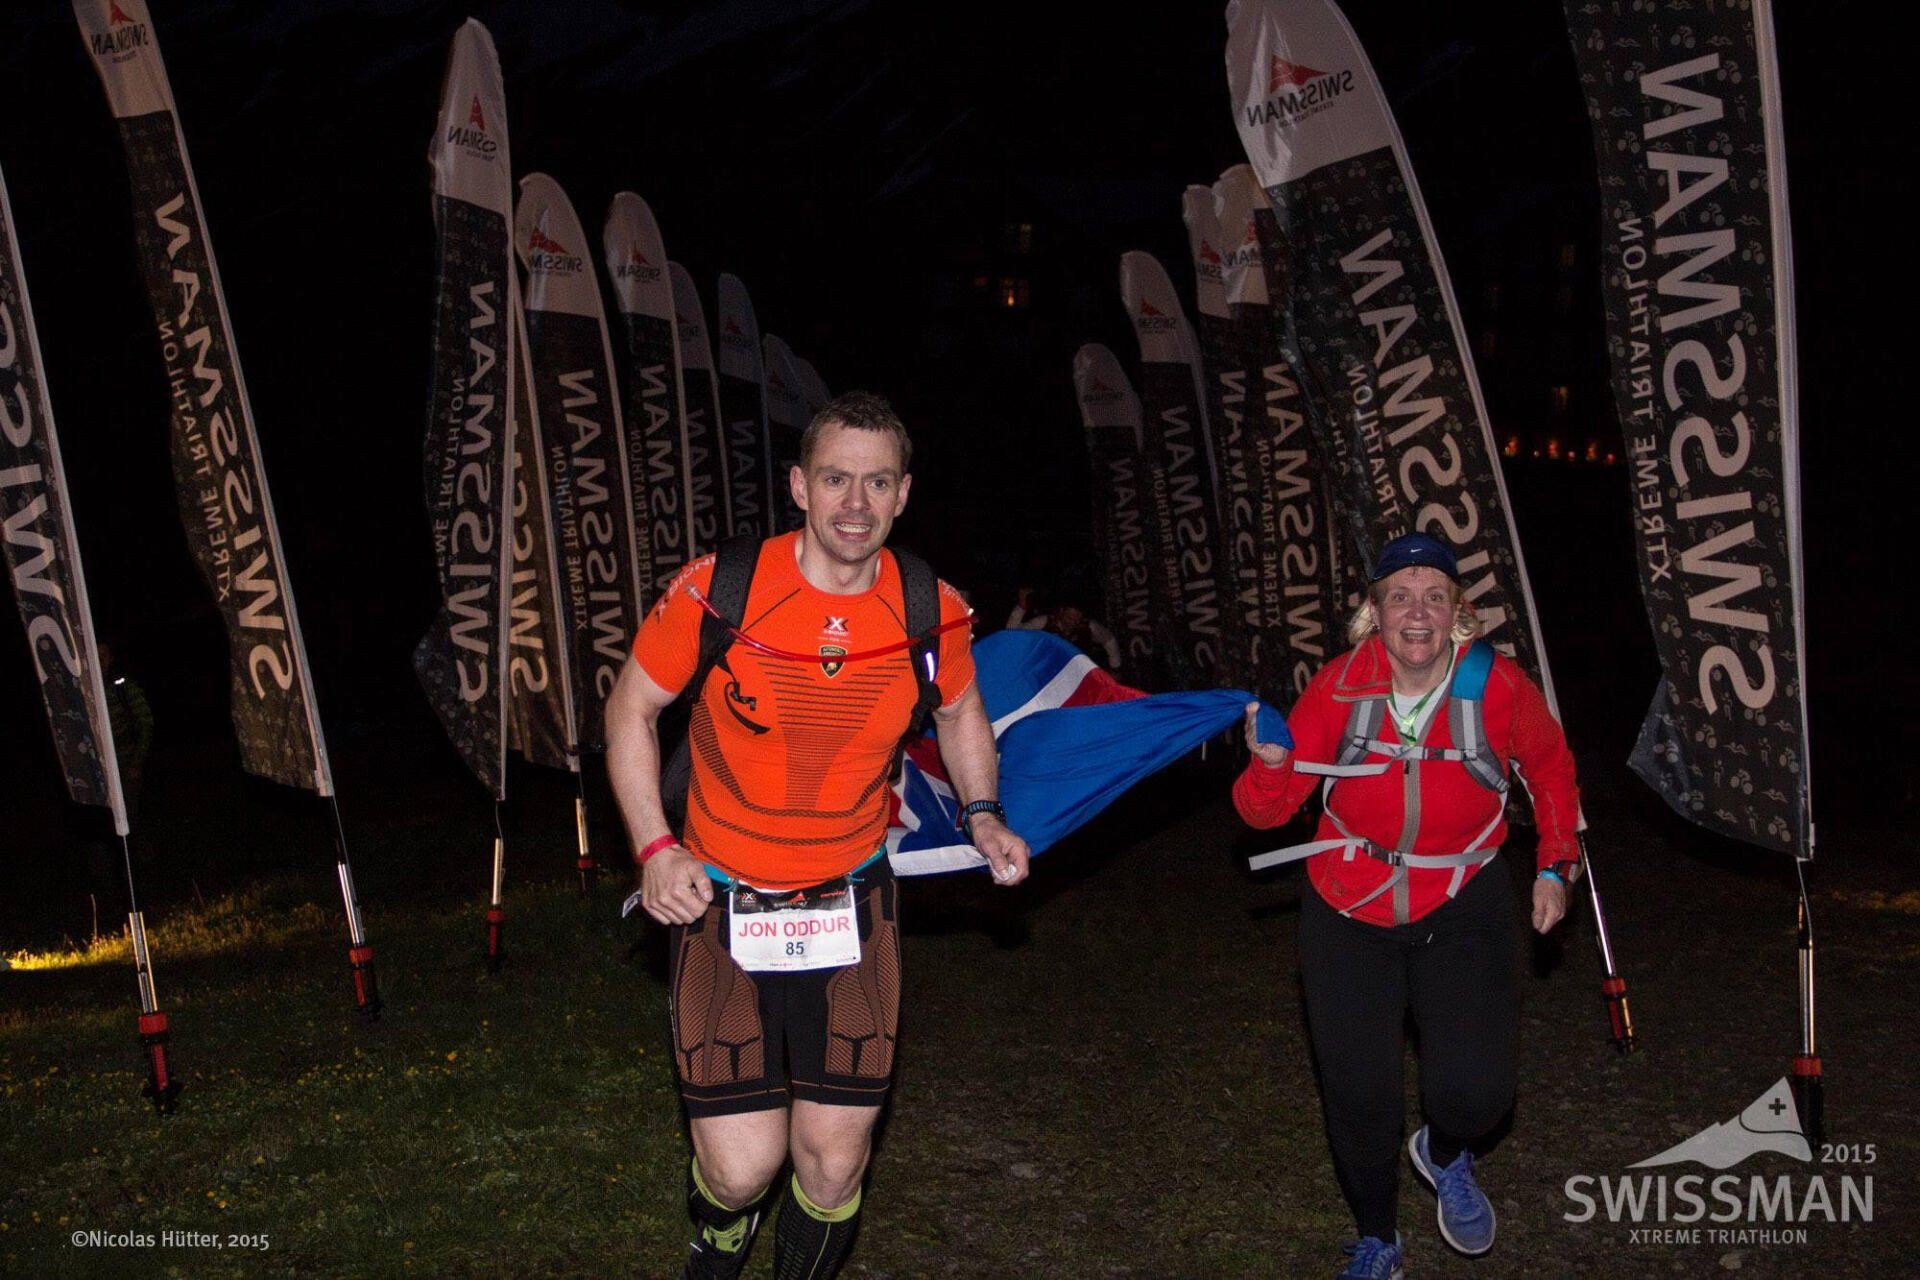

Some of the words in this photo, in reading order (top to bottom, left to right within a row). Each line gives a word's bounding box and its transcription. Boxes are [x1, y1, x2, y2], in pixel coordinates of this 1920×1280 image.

[739, 922, 777, 937] JON
[784, 916, 851, 937] ODDUR
[785, 942, 805, 956] 85
